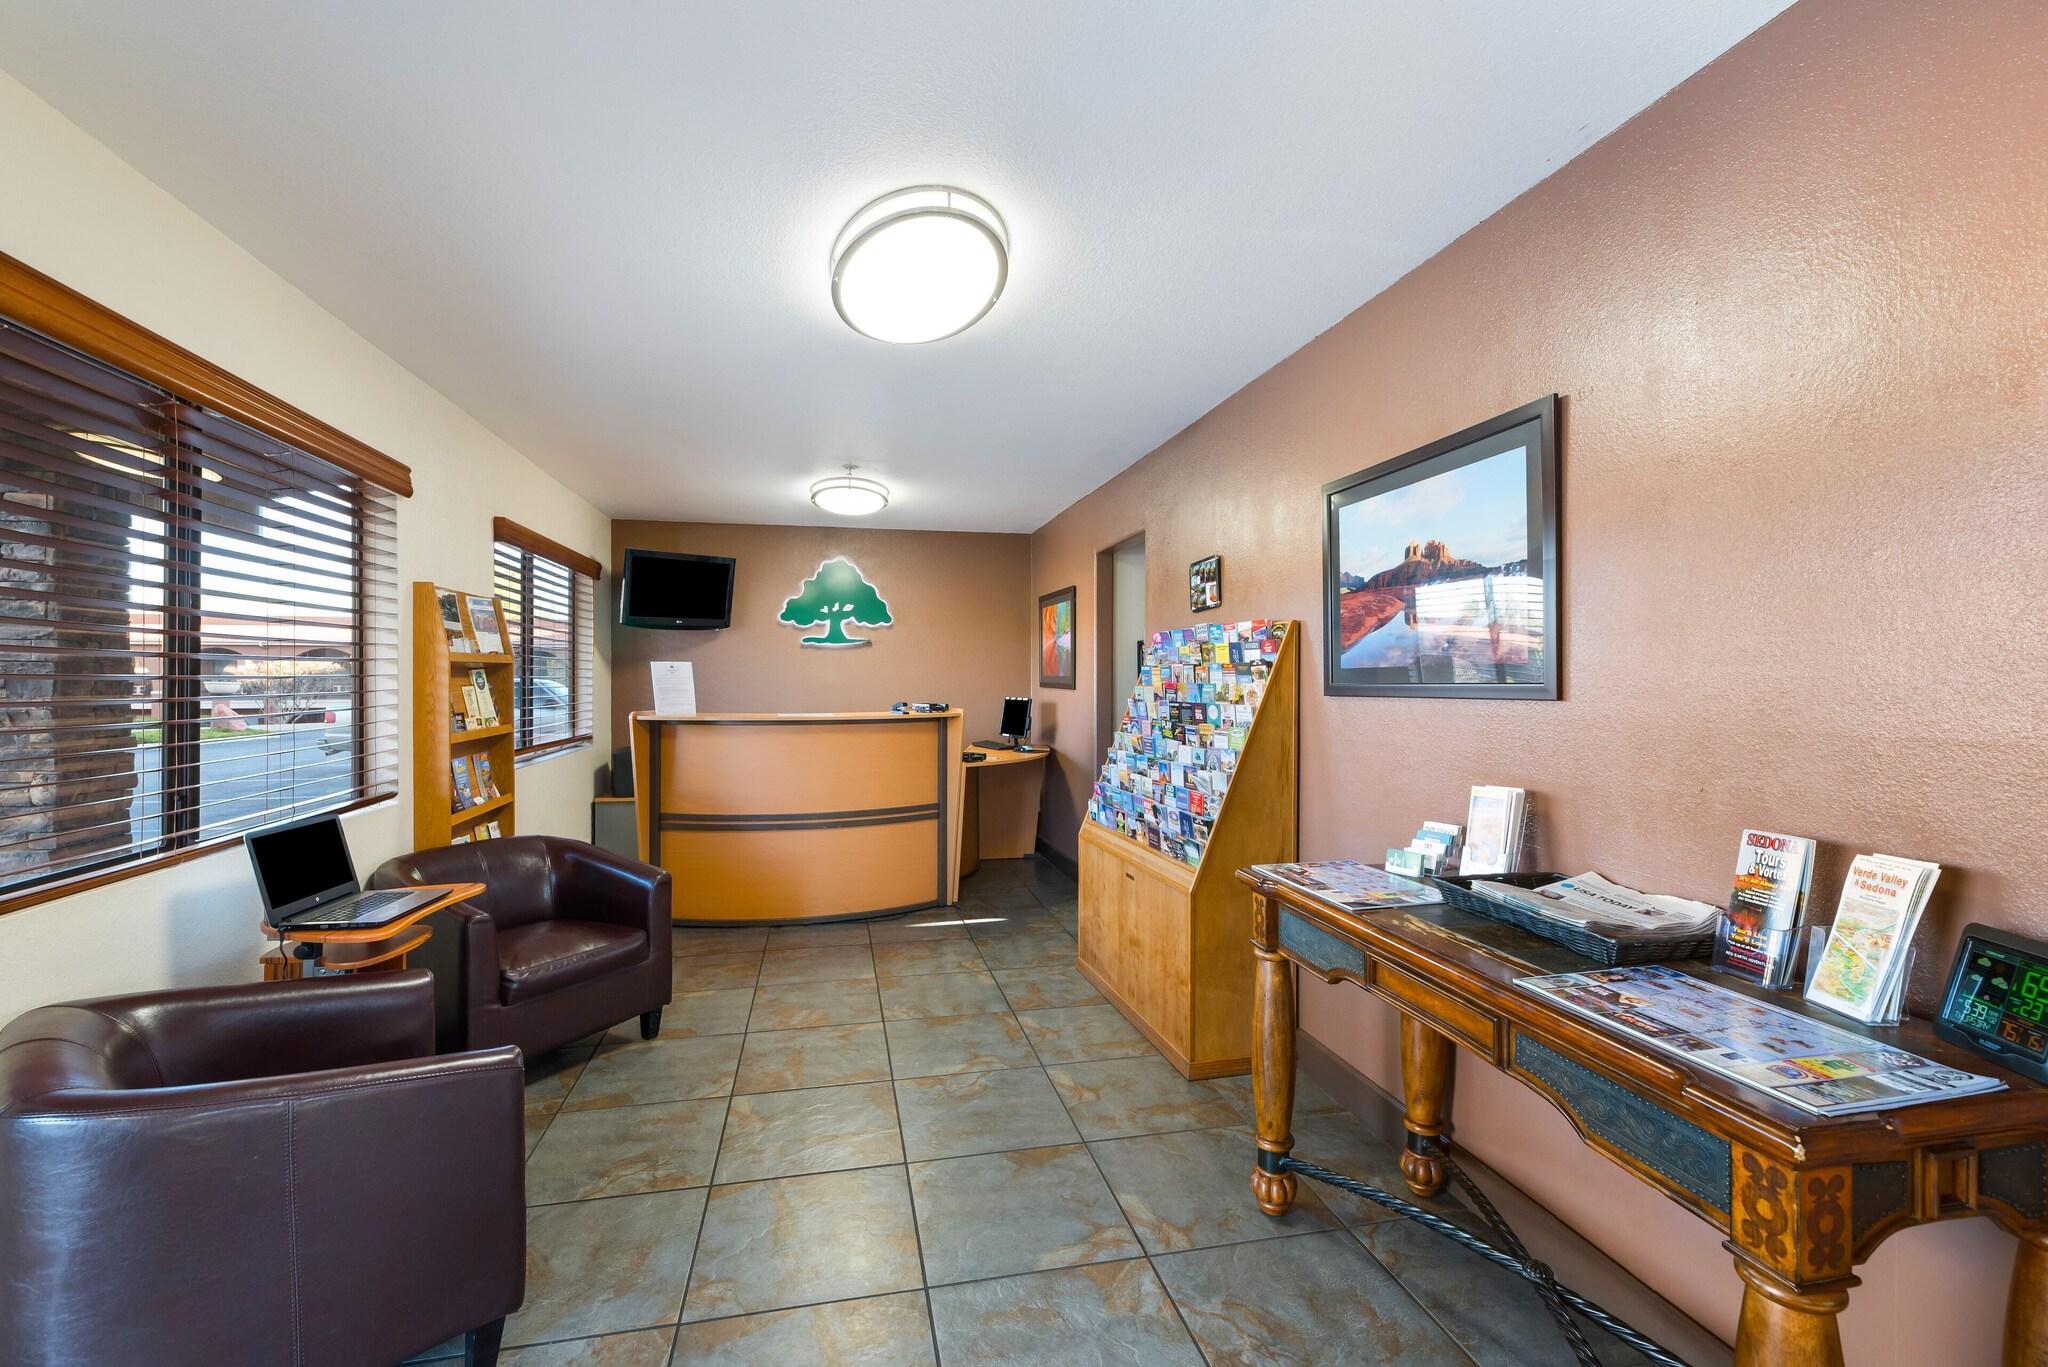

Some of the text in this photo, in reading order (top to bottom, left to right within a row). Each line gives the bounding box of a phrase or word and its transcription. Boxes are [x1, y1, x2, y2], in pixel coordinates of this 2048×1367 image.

[1748, 864, 1756, 875] &
[1755, 850, 1786, 869] Tours
[1853, 866, 1909, 889] Verde Valley
[1573, 887, 1596, 897] USA
[1597, 896, 1638, 910] TODAY
[1860, 880, 1898, 897] Sedona
[2020, 999, 2044, 1021] 23
